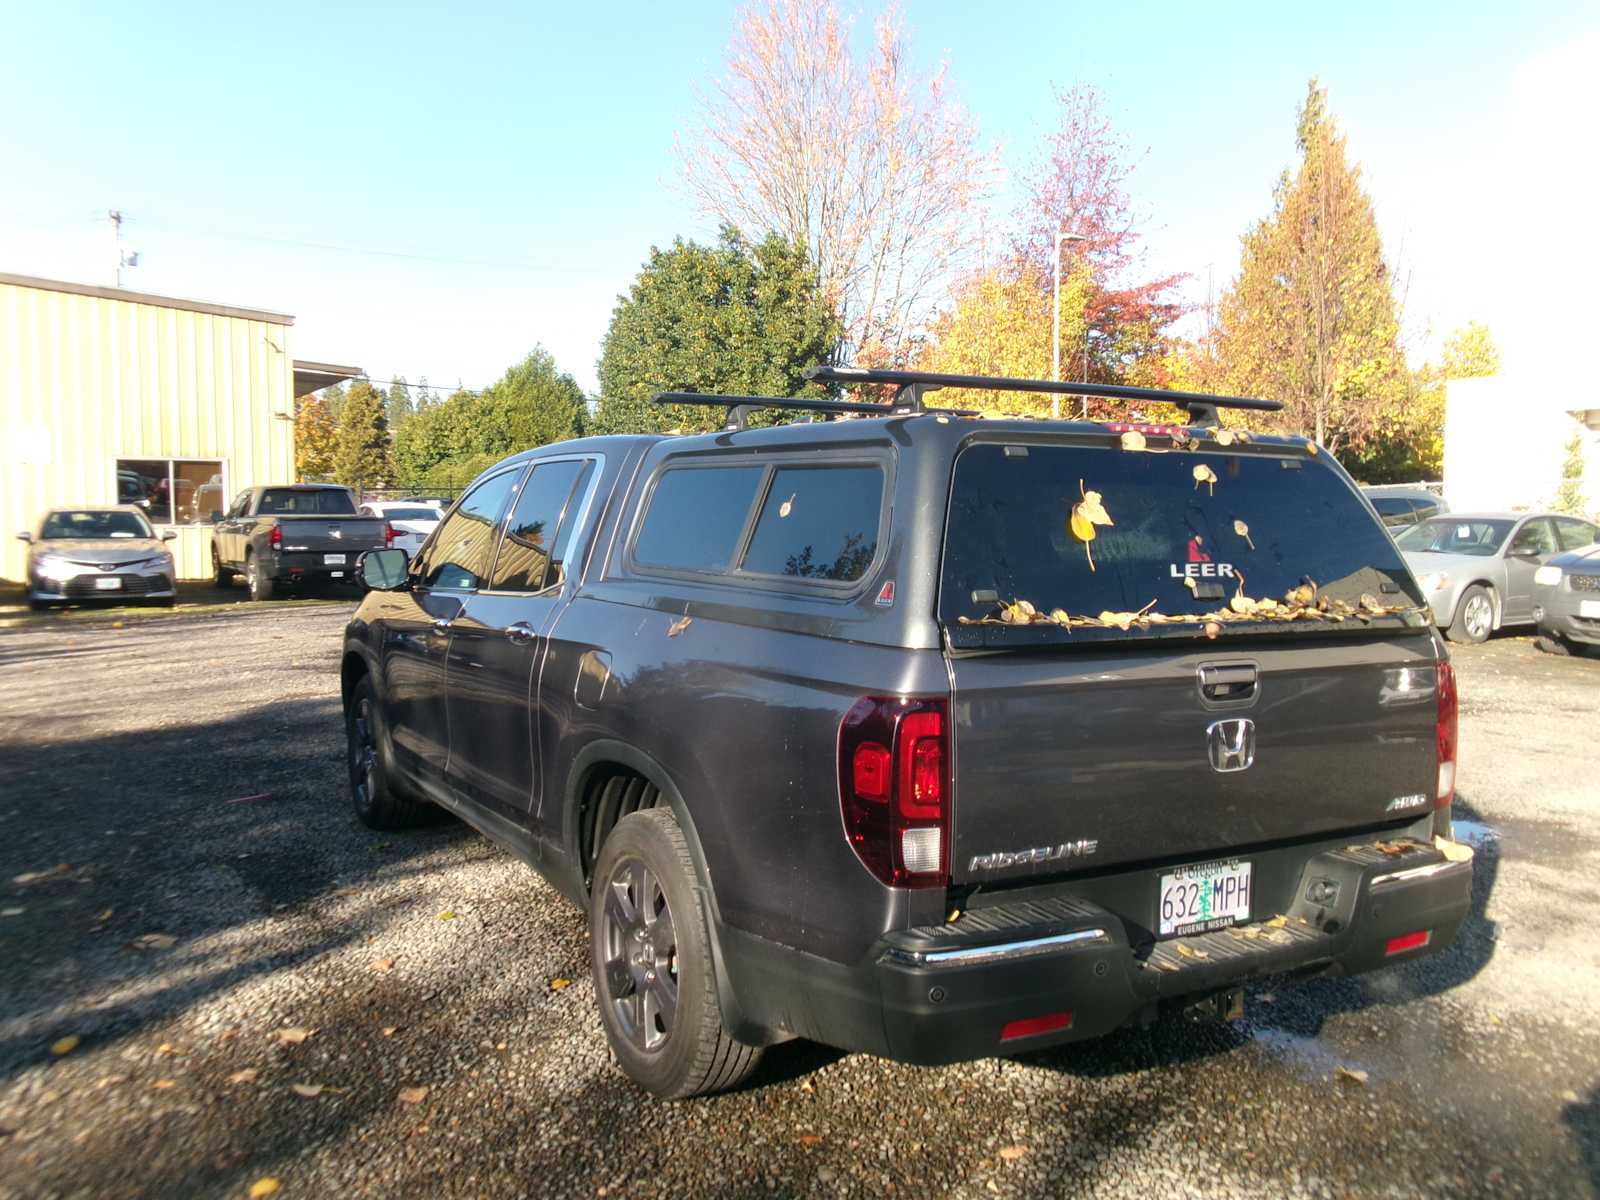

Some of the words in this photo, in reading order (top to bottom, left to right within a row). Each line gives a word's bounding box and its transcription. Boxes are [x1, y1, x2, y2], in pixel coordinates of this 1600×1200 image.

[1170, 563, 1234, 578] LEER
[968, 839, 1098, 872] RIDGELINE
[1162, 883, 1199, 921] 632
[1213, 874, 1249, 912] MPH
[1177, 921, 1206, 936] EUGENE
[1208, 916, 1234, 930] NISSAN
